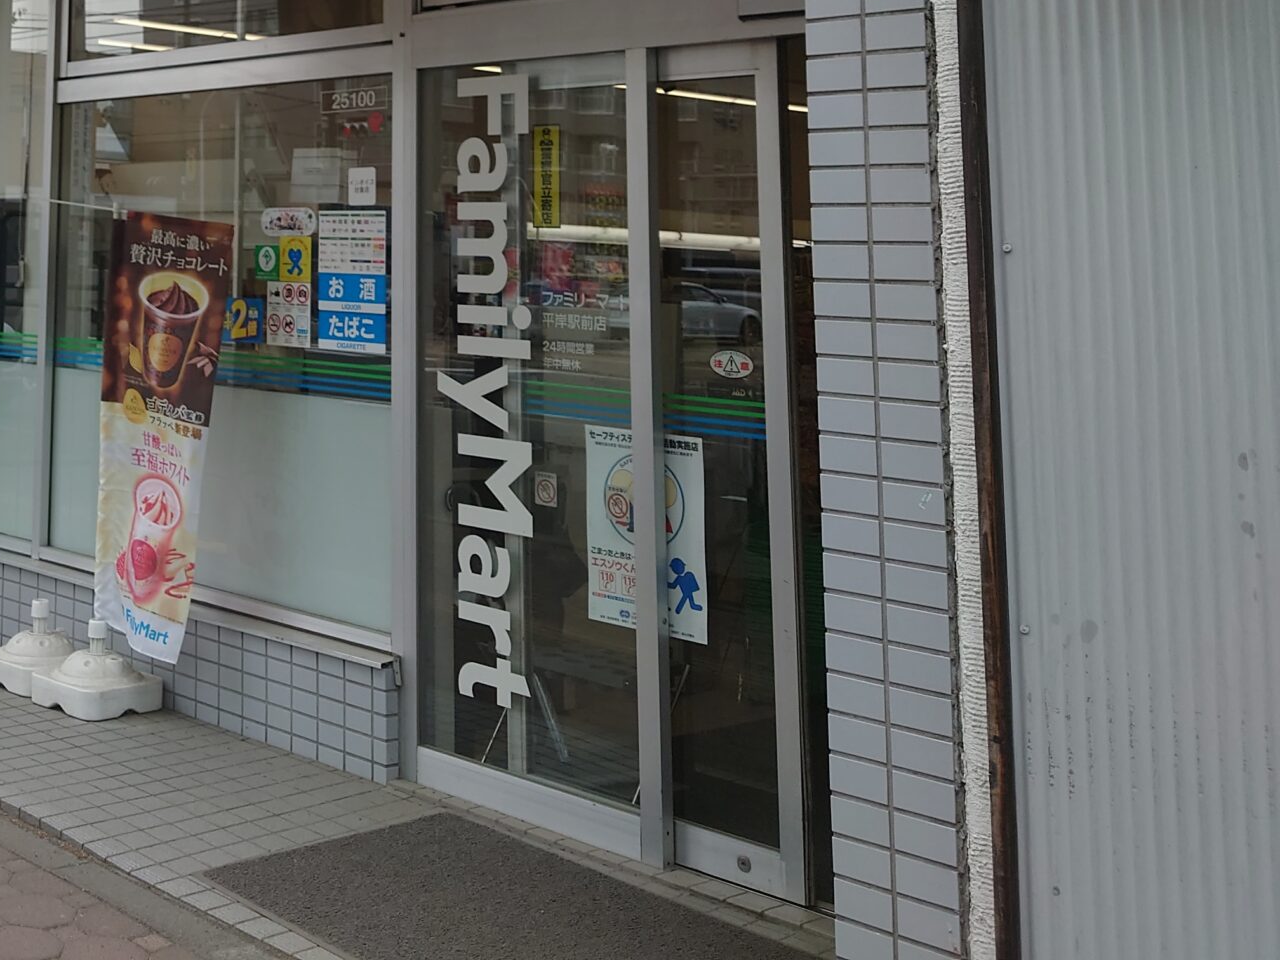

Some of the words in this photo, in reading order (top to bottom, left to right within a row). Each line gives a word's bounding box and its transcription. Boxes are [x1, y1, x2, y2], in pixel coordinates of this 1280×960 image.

[331, 90, 376, 110] 25100
[129, 243, 229, 277] 贅沢チョコレート
[328, 276, 377, 301] お酒
[341, 303, 362, 311] LIQUOR
[542, 291, 630, 311] ファミリーマート
[328, 315, 375, 339] たばこ
[542, 312, 607, 332] 平岸駅前店
[336, 342, 367, 351] CIGARETTE
[542, 341, 595, 355] 24時間営業
[543, 357, 582, 371] 年中無休
[437, 73, 534, 709] FamilyMart
[131, 447, 191, 488] 至福ホワイト
